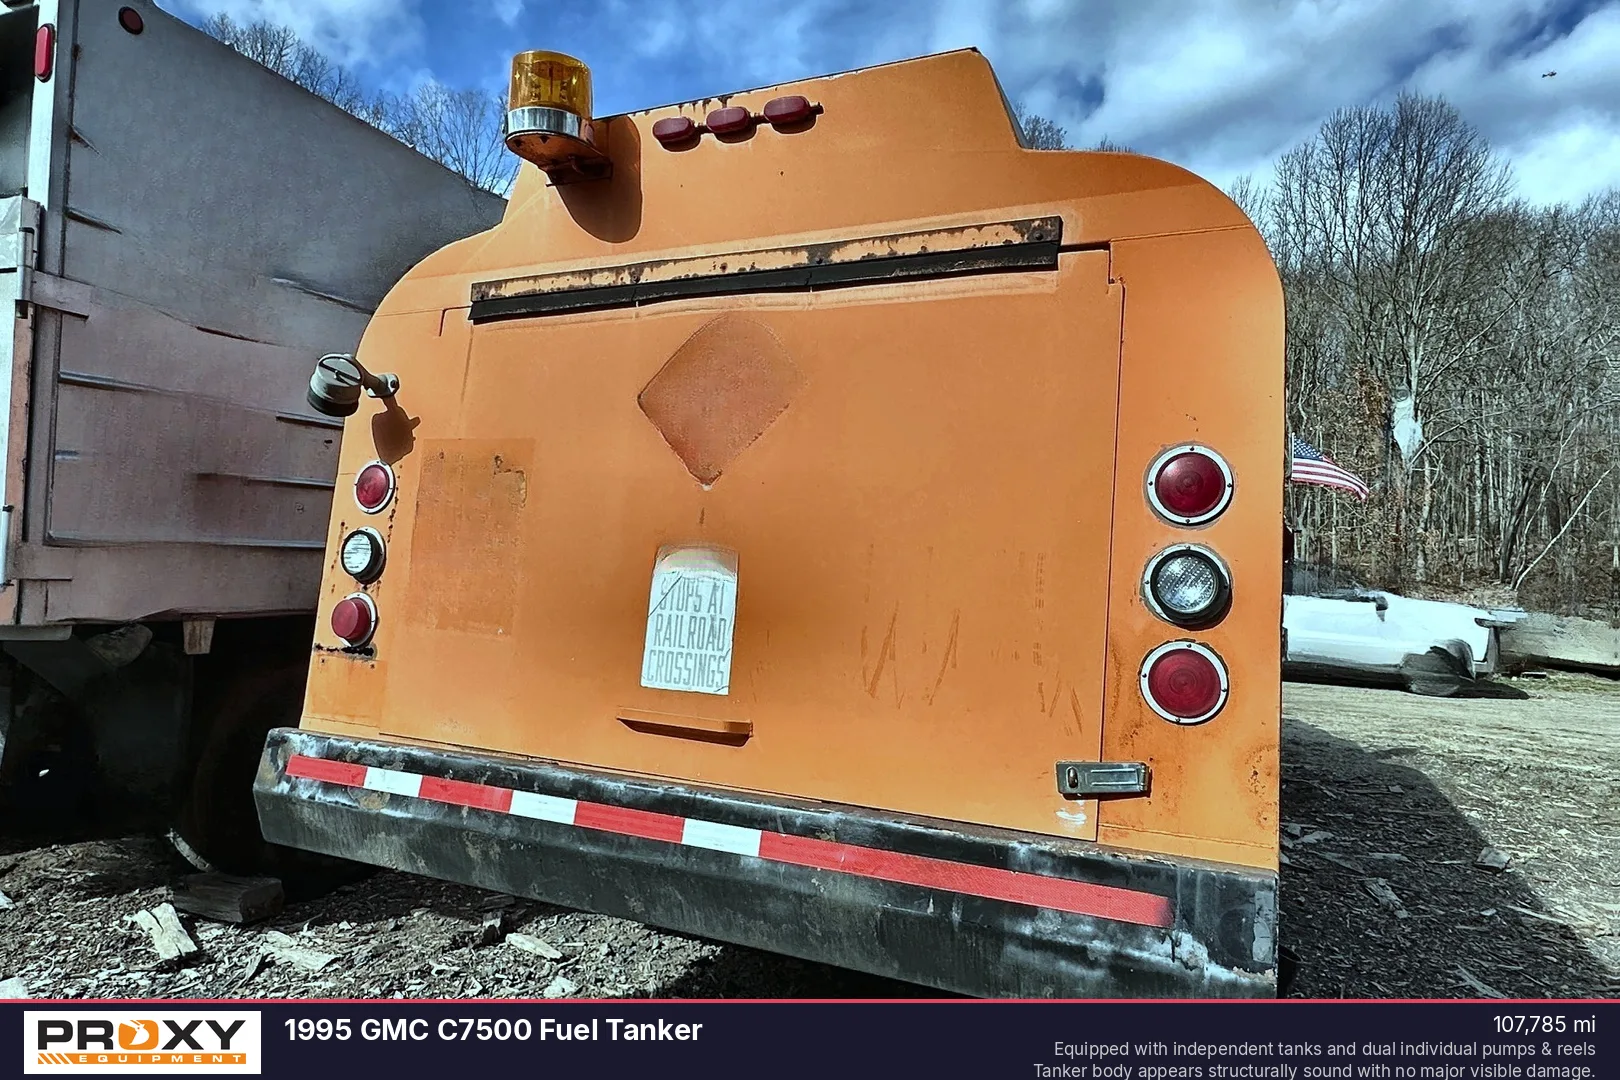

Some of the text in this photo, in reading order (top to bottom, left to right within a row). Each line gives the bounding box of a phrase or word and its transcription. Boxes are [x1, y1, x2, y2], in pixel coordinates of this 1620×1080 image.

[659, 578, 726, 615] STOPS AT
[653, 613, 727, 652] RAILROAD
[646, 649, 726, 688] CROSSINGS
